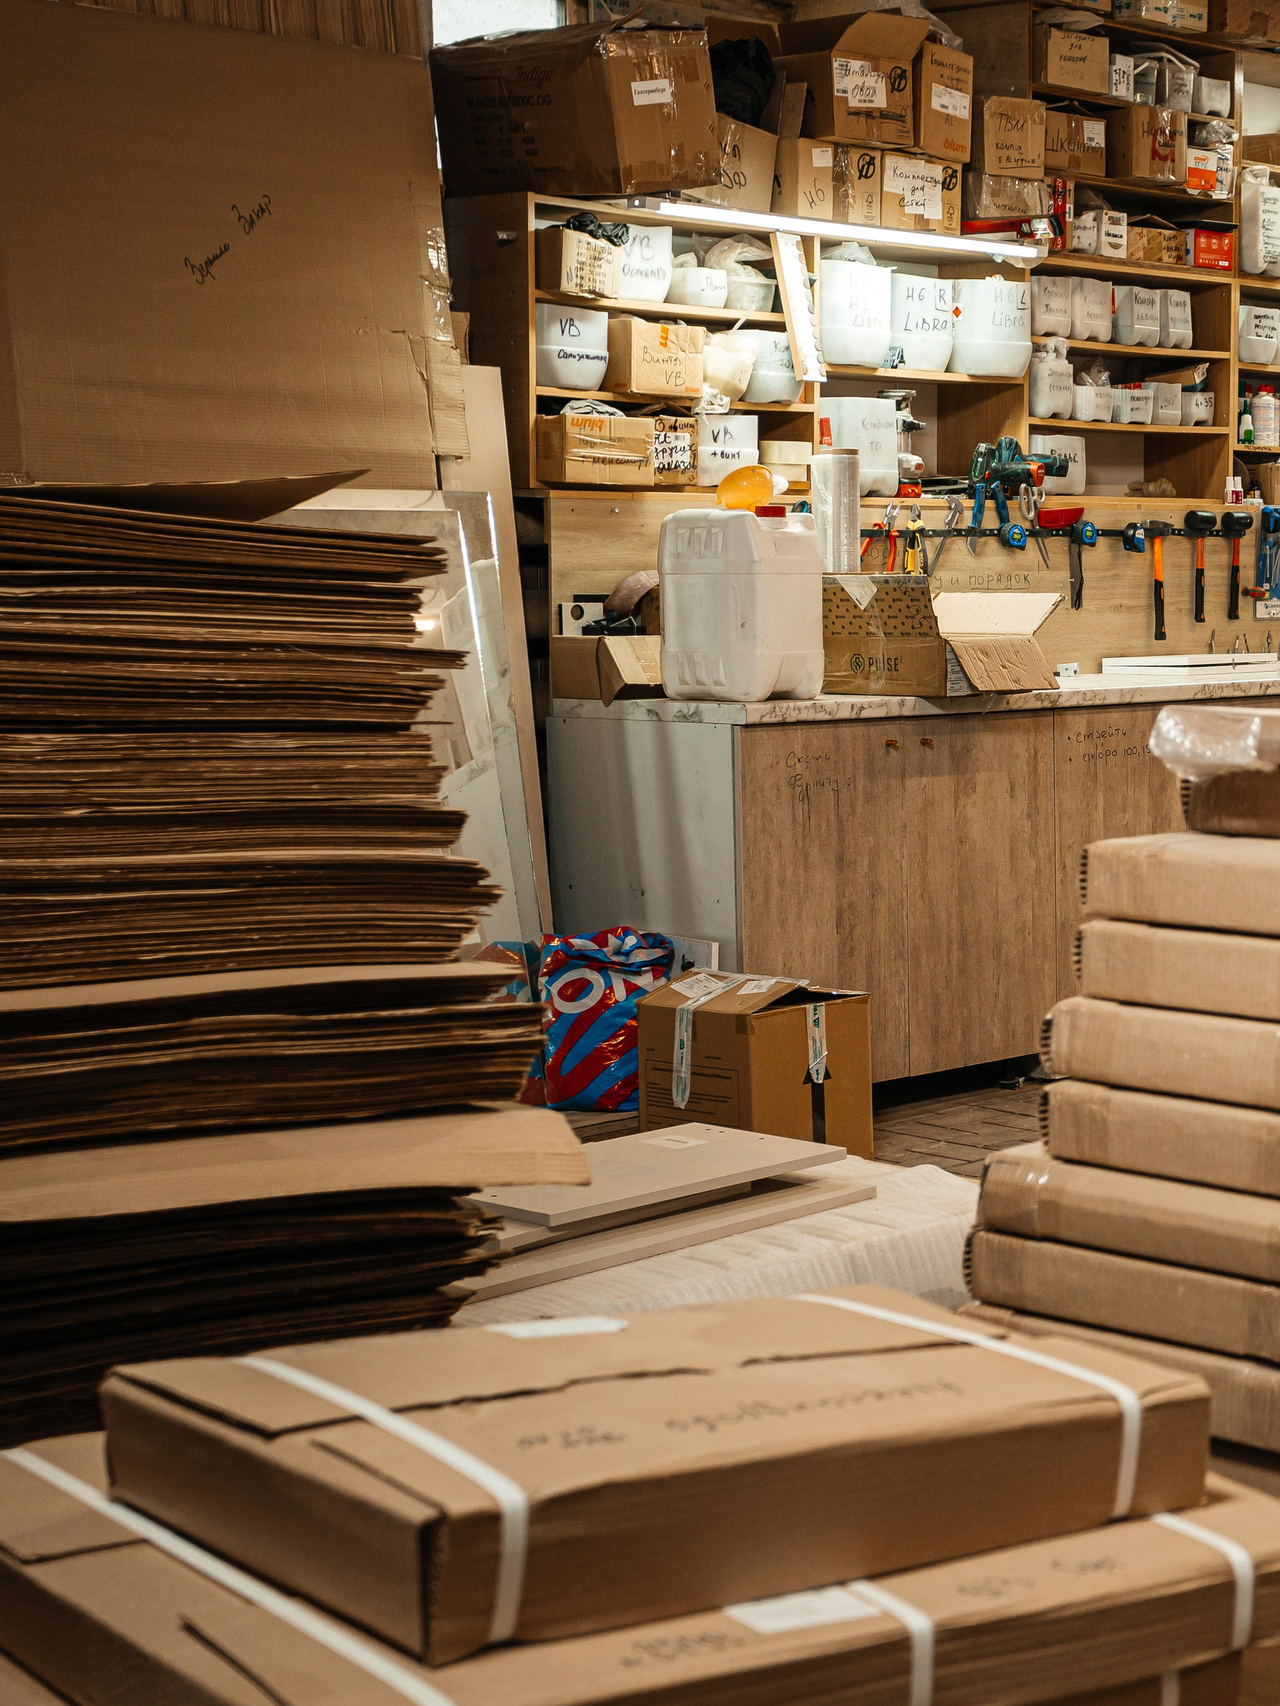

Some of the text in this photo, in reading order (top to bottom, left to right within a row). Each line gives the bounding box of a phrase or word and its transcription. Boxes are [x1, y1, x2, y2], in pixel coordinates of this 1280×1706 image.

[514, 66, 554, 90] Indigo
[634, 85, 667, 97] Екатеринбург
[943, 138, 967, 154] blum
[559, 317, 581, 338] VB
[665, 370, 686, 387] VB
[570, 417, 606, 433] blum
[968, 574, 1031, 590] порядок
[868, 656, 899, 673] PULSE
